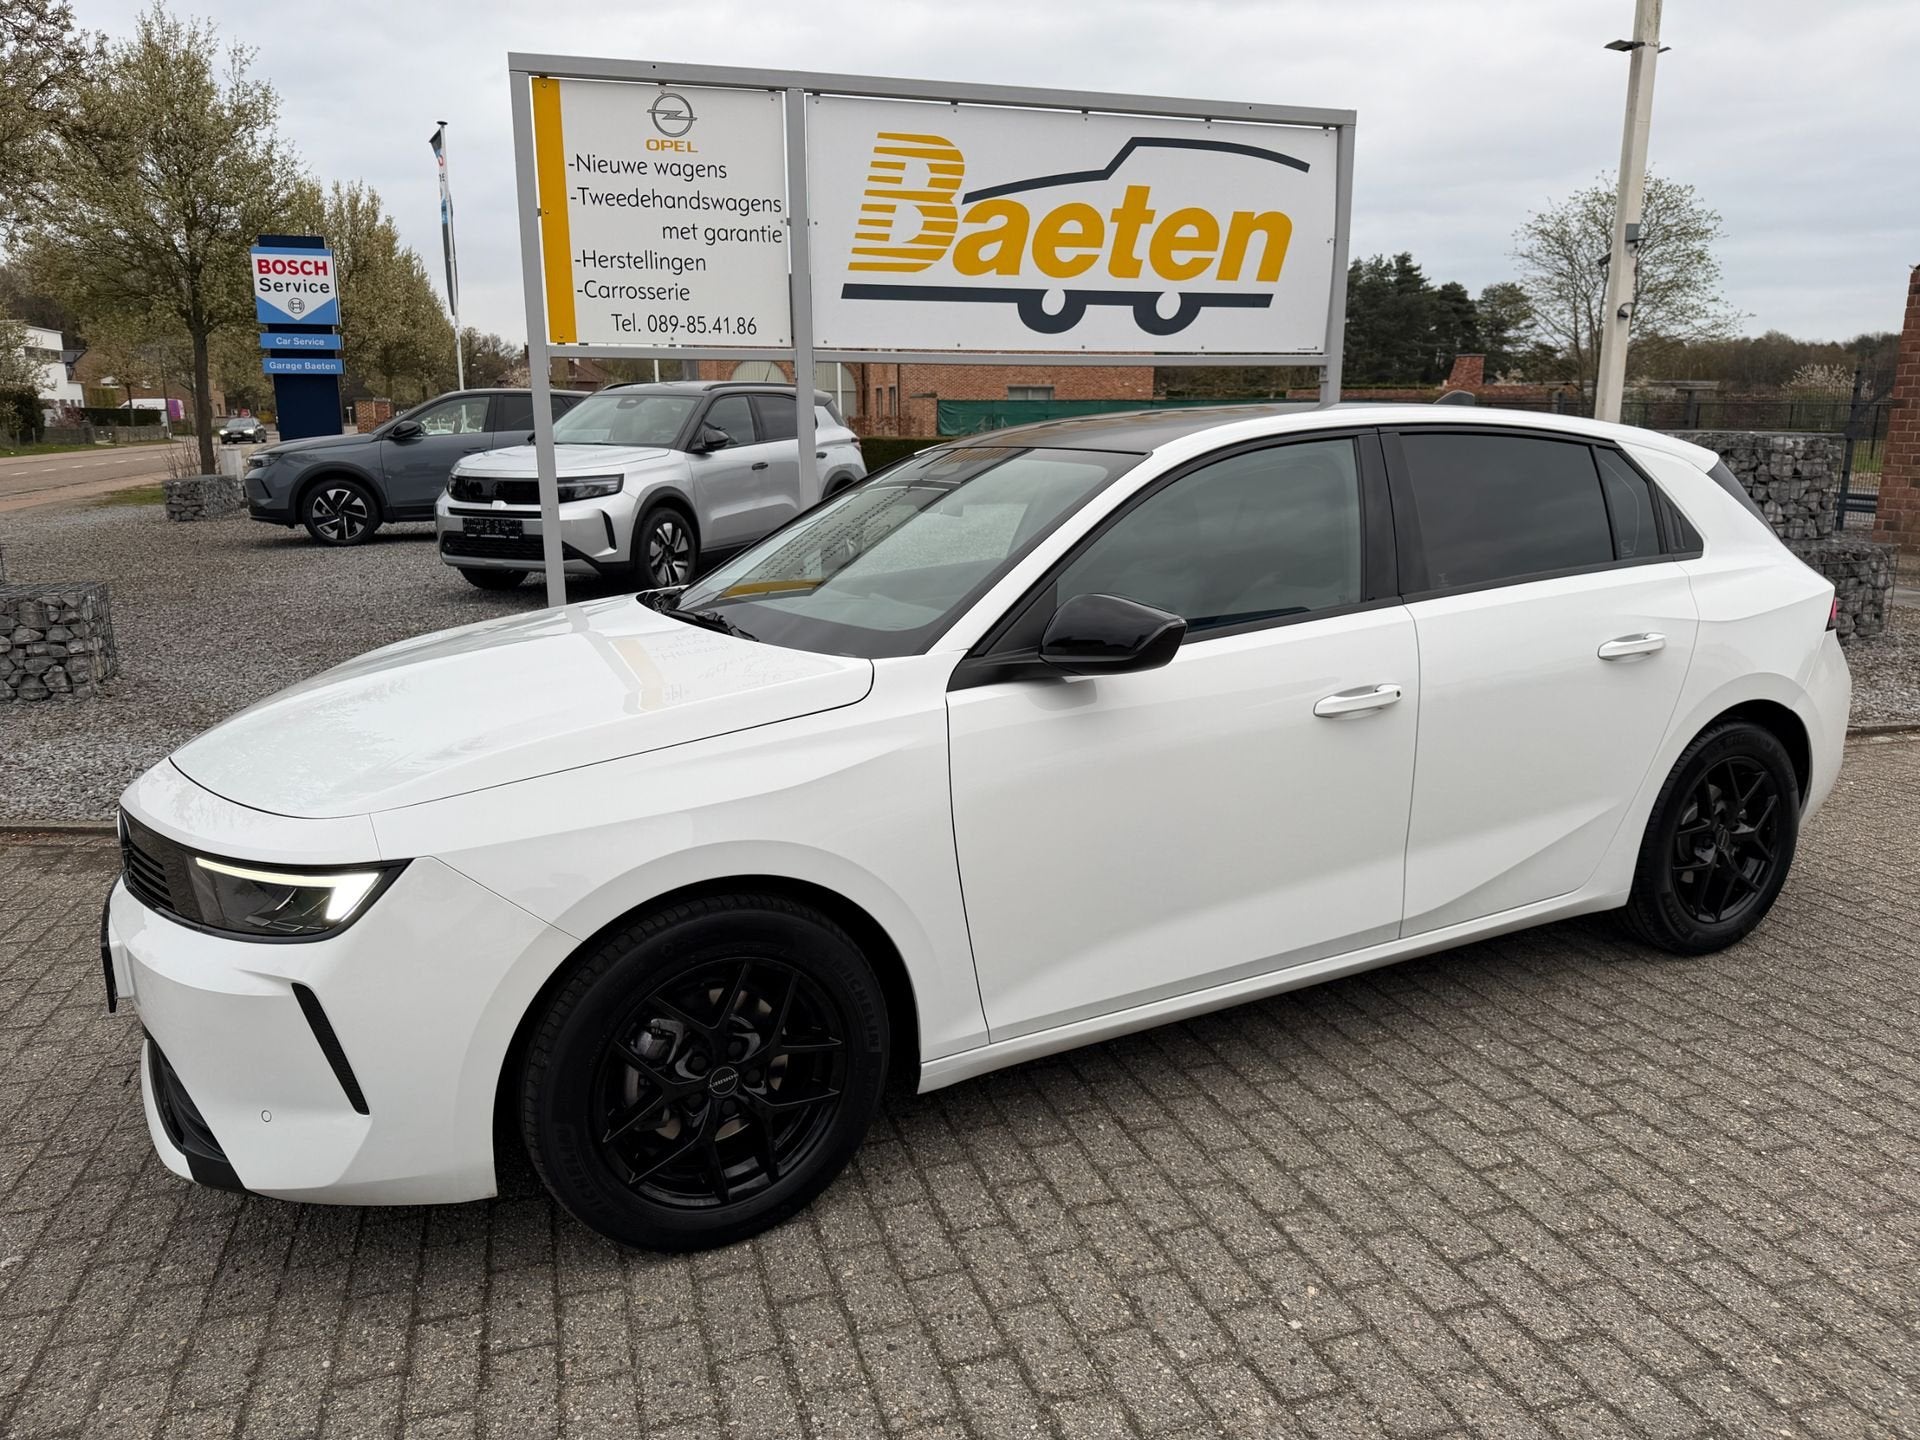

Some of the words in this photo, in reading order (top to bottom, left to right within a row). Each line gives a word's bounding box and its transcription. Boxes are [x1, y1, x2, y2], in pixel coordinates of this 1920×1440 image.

[645, 139, 699, 153] OPEL
[568, 153, 648, 175] -Nieuwe
[654, 162, 727, 182] wagens
[570, 186, 782, 216] -Tweedehandswagens
[847, 131, 1293, 283] Baeten
[662, 223, 698, 241] met
[704, 224, 783, 246] garantie
[256, 258, 328, 276] BOSCH
[574, 249, 707, 275] -Herstellingen
[259, 277, 330, 294] Service
[576, 279, 690, 301] -Carrosserie
[611, 312, 641, 333] Tel.
[647, 314, 757, 335] 089-85.41.86
[275, 336, 291, 346] Car
[293, 337, 325, 346] Service
[269, 361, 302, 371] Garage
[304, 361, 336, 370] Baeten
